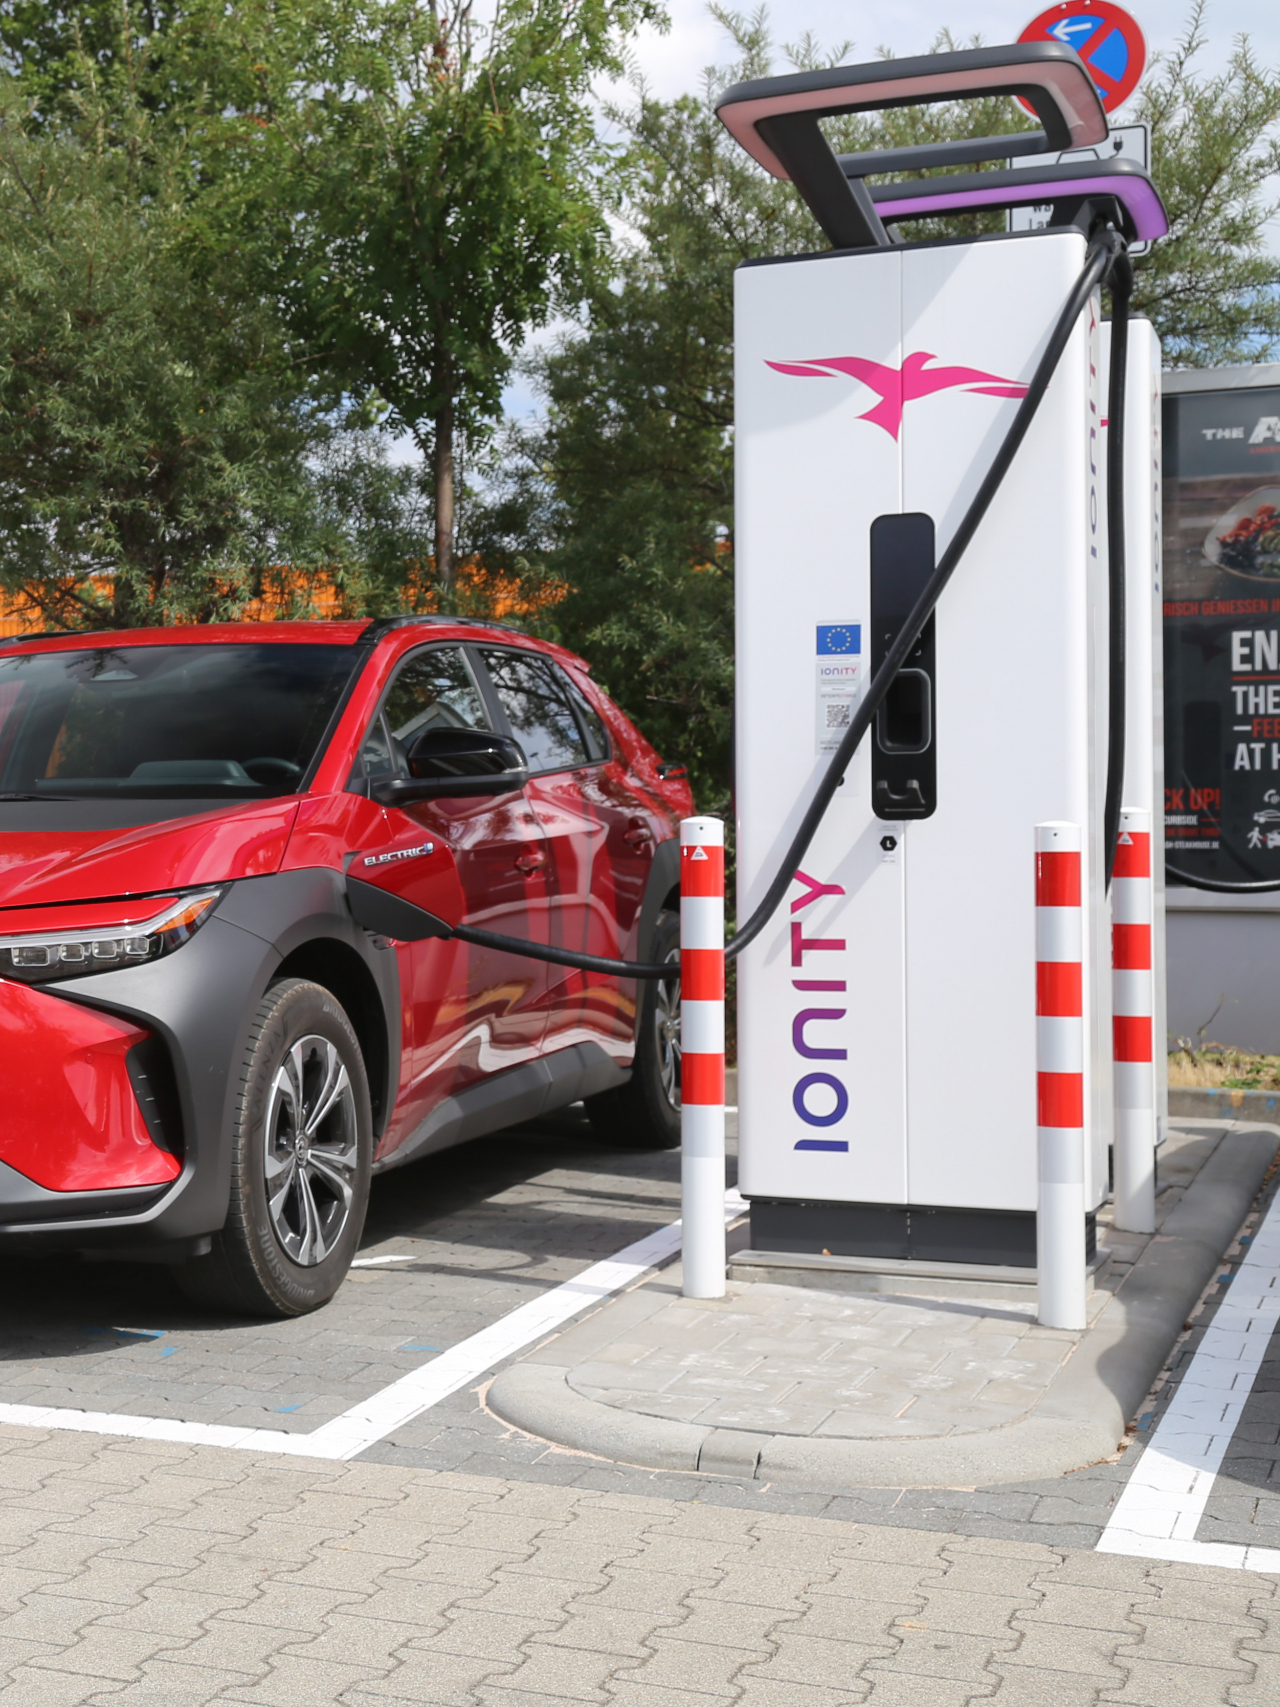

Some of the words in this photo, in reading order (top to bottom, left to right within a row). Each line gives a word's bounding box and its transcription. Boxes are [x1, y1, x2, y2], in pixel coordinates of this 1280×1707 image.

[1201, 426, 1245, 441] THE
[1201, 599, 1269, 615] GENIESSEN
[1231, 629, 1280, 671] EN
[821, 667, 858, 676] IONITY
[1231, 684, 1280, 715] THE
[1233, 743, 1266, 771] AT
[1190, 787, 1221, 811] UP!
[364, 845, 428, 867] ELECTRIC
[791, 869, 849, 1153] IONITY
